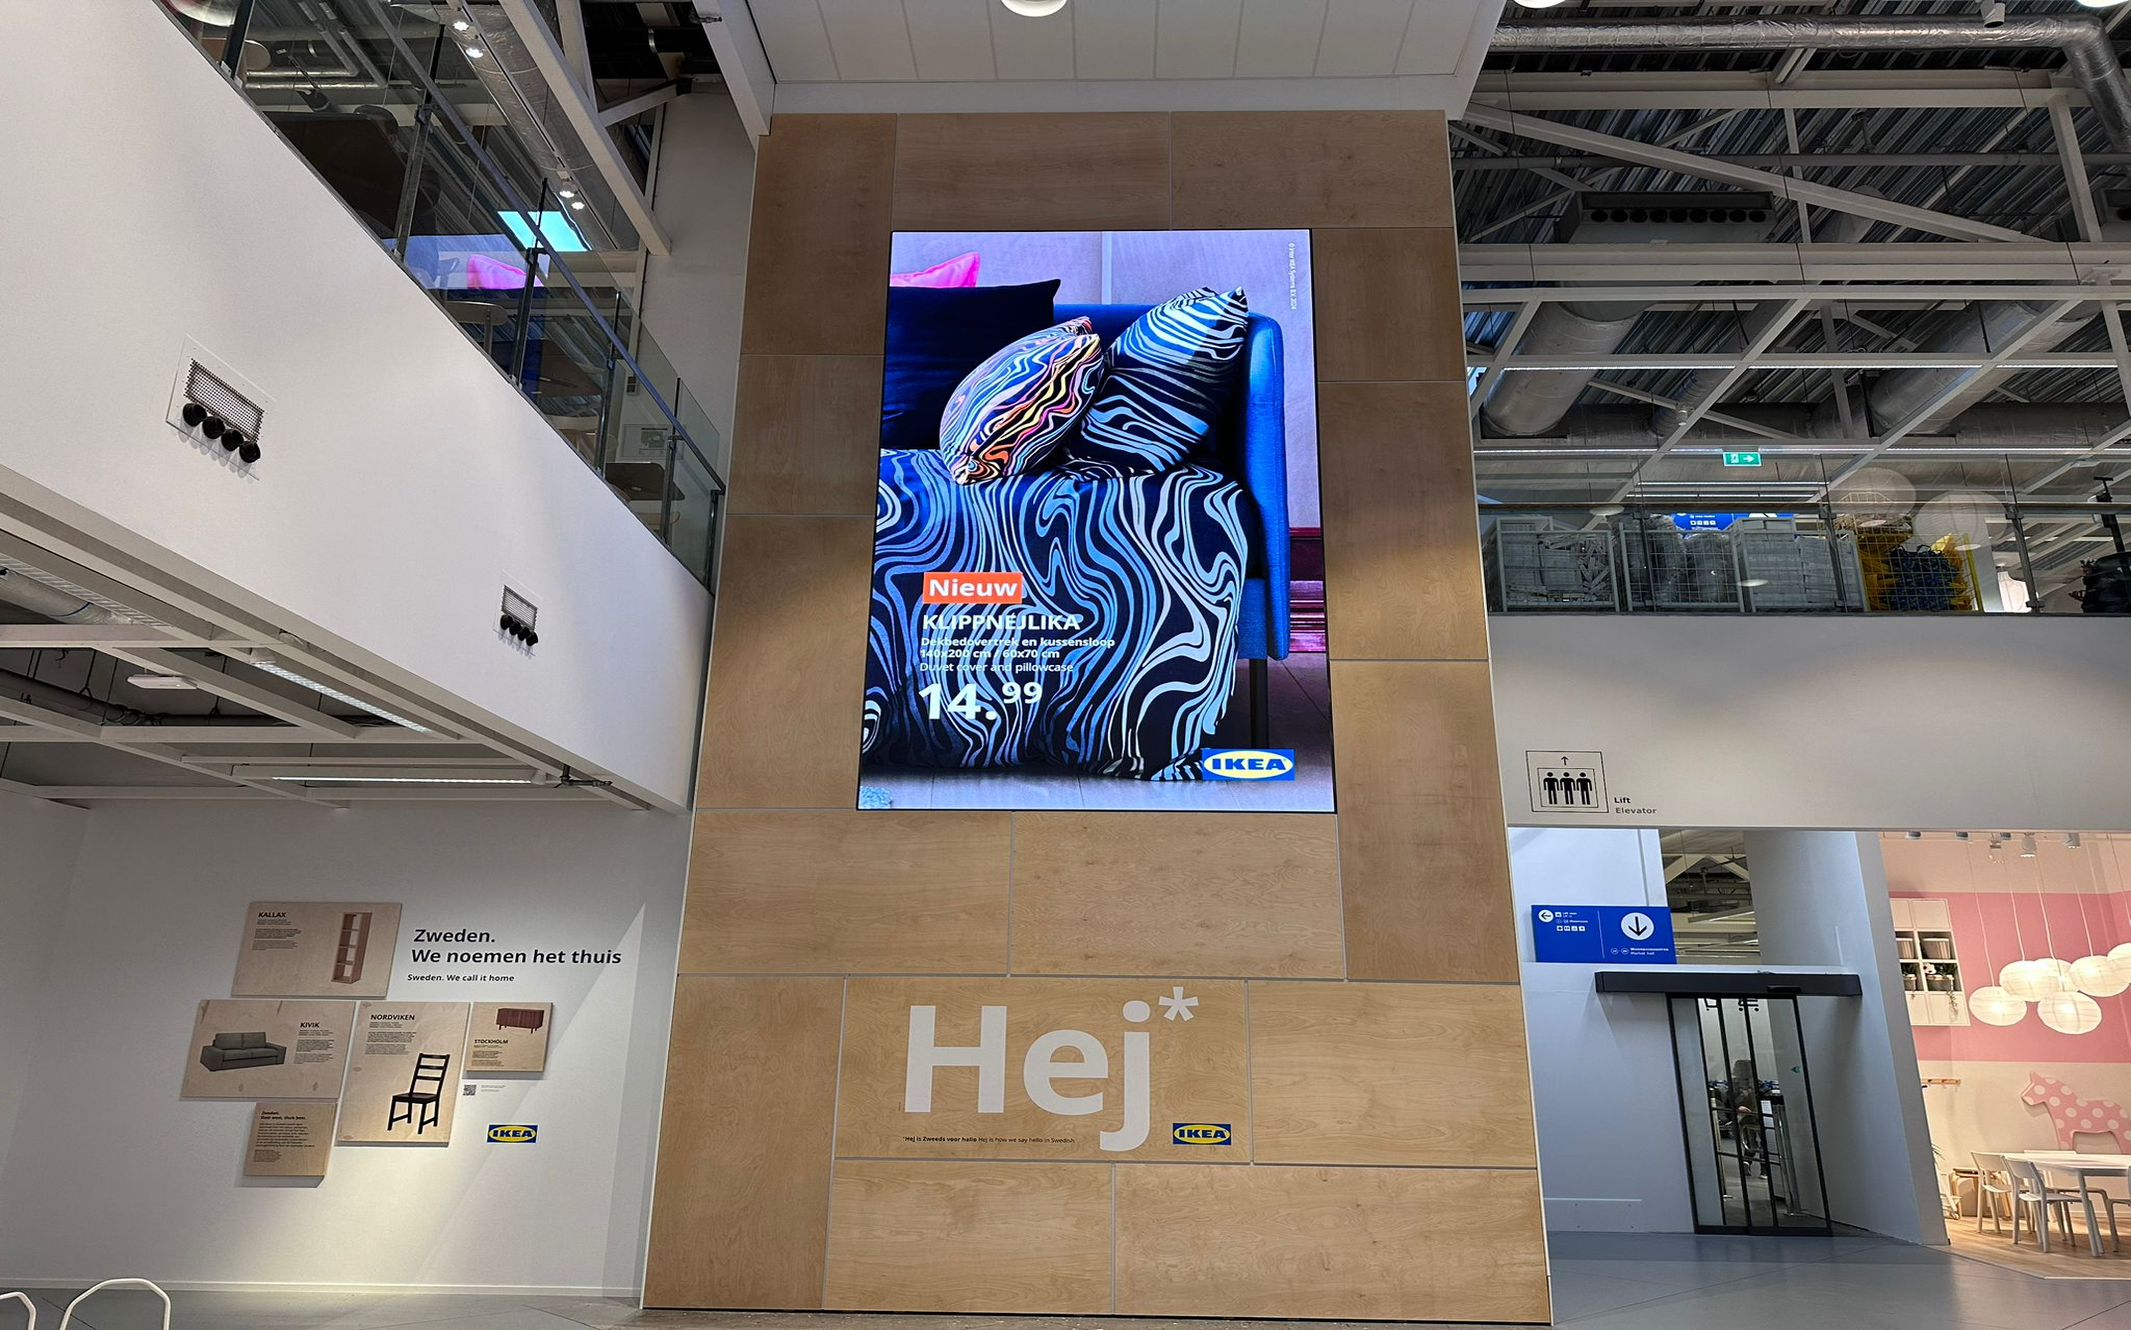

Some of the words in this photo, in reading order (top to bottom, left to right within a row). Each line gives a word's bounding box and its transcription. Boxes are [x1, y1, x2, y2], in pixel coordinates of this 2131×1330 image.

[929, 579, 1018, 597] Nieuw
[921, 637, 1019, 647] Dekbedovertrek
[1021, 639, 1037, 647] en
[1040, 637, 1115, 649] kussensloop
[920, 649, 969, 659] 140x200
[972, 651, 992, 659] cm
[1002, 649, 1038, 659] 60x70
[1041, 651, 1060, 659] cm
[920, 662, 954, 672] Duvet
[990, 662, 1012, 672] and
[1015, 662, 1074, 674] pillowcase
[1212, 758, 1287, 771] IKEA
[1614, 796, 1631, 804] Lift
[413, 928, 496, 943] Zweden.
[411, 949, 441, 963] We
[446, 949, 527, 963] noemen
[532, 949, 566, 964] het
[571, 949, 622, 964] thuis
[407, 974, 444, 982] Sweden.
[446, 974, 461, 982] We
[462, 974, 478, 982] call
[480, 974, 487, 982] it
[489, 974, 515, 982] home
[492, 1129, 533, 1138] IKEA
[1178, 1129, 1227, 1139] IKEA
